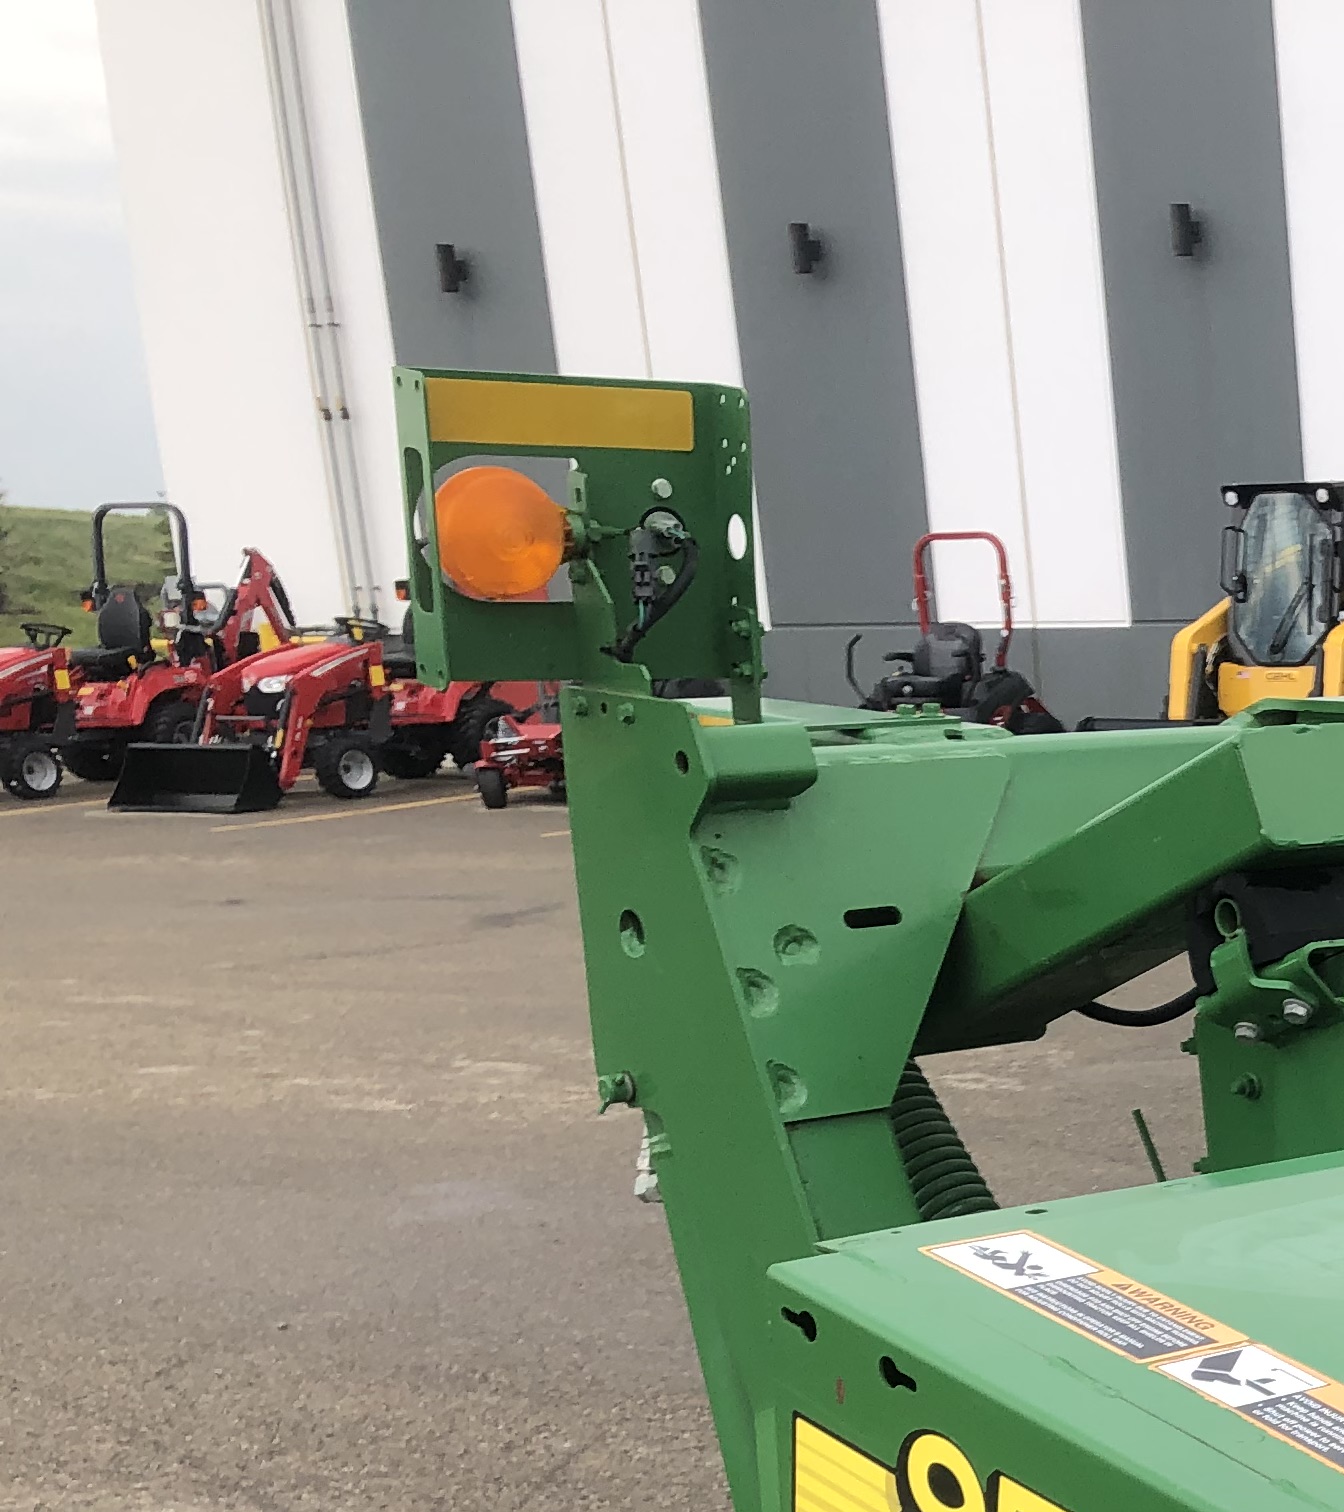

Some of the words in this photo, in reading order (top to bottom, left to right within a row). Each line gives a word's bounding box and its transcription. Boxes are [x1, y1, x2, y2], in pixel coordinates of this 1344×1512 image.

[1129, 1289, 1214, 1330] WARNING
[1292, 1394, 1321, 1409] AVOID
[1287, 1401, 1309, 1413] Keep
[1307, 1412, 1334, 1426] hands
[1282, 1417, 1298, 1425] off
[1292, 1424, 1321, 1438] power
